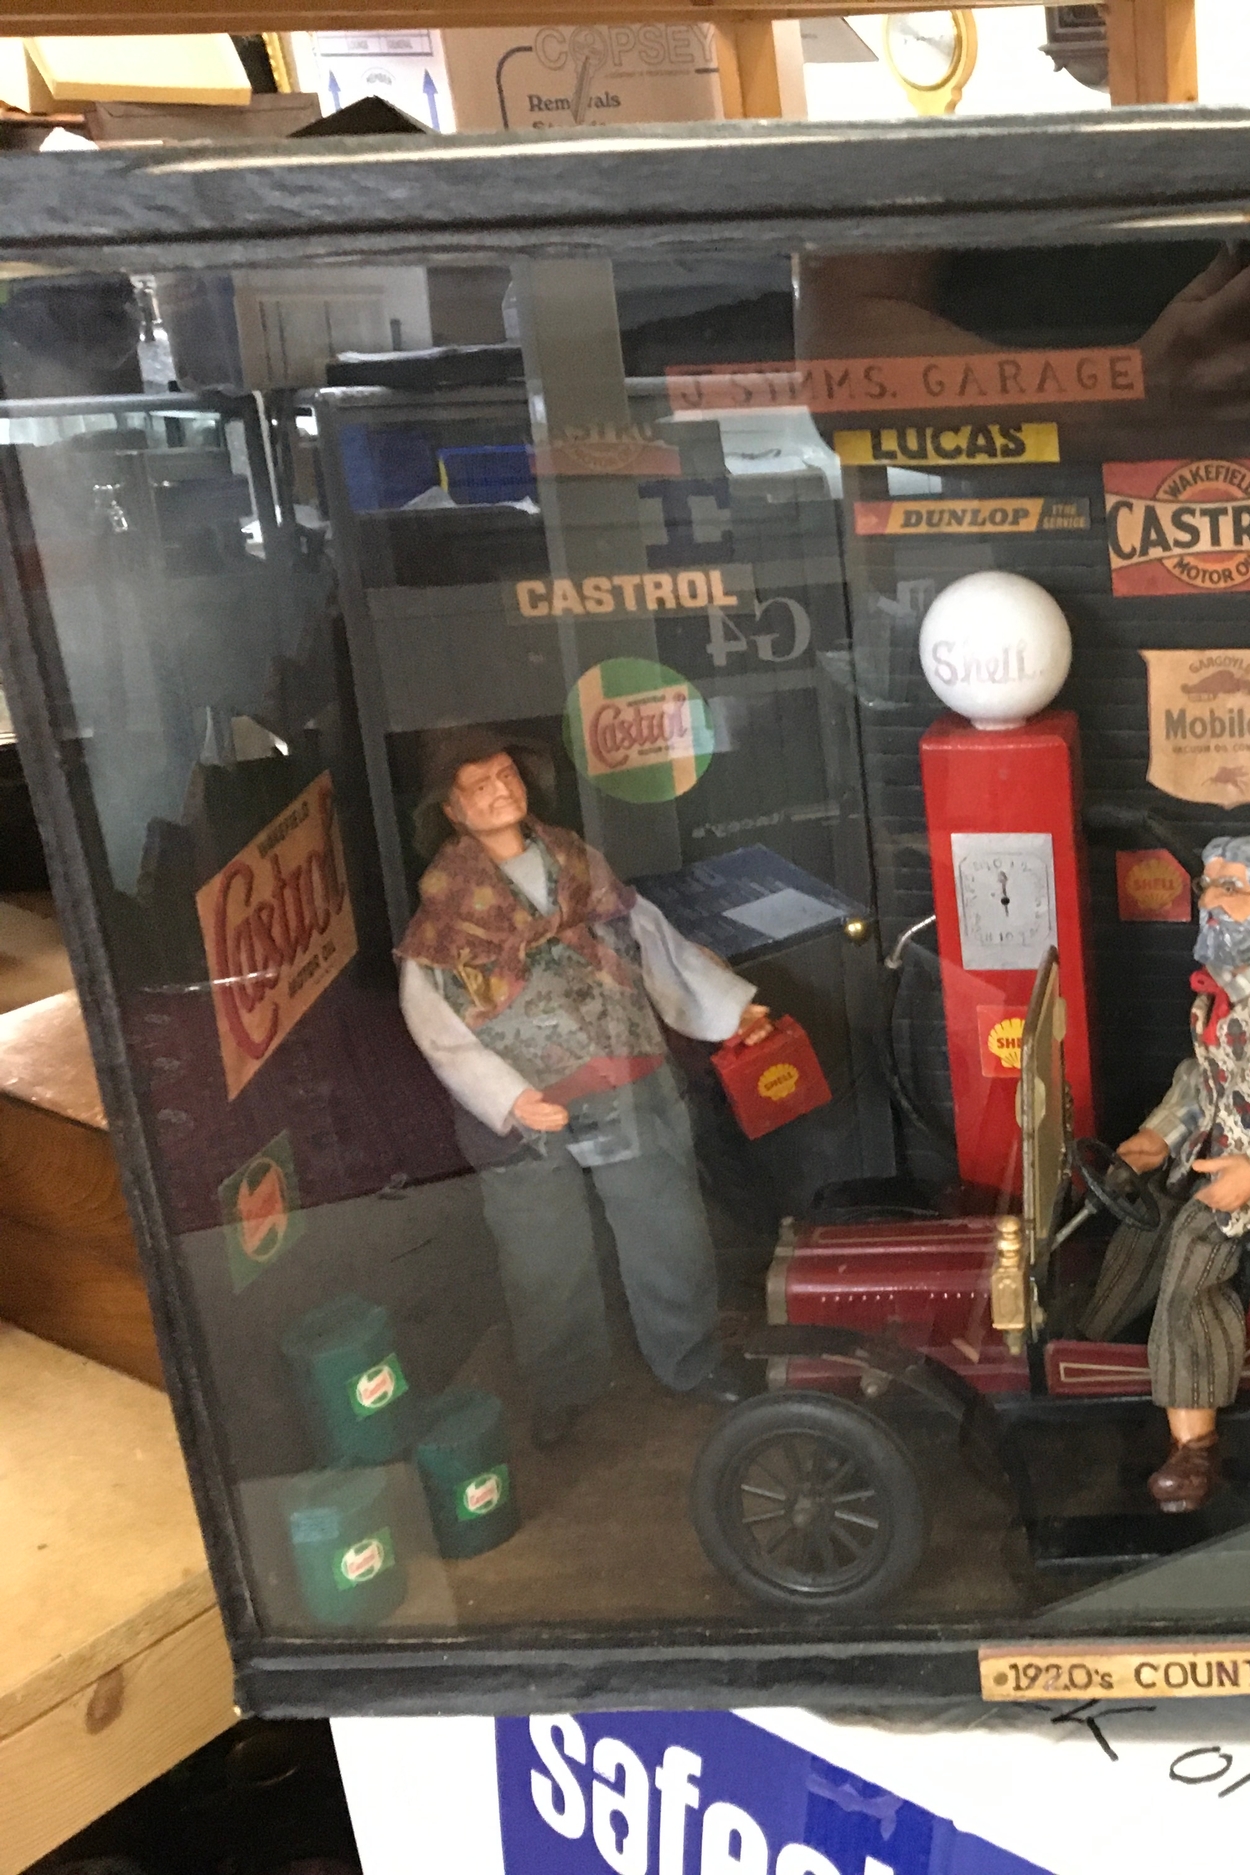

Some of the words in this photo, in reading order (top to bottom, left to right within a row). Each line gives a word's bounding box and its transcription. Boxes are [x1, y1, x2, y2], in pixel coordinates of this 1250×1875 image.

[534, 23, 715, 71] COPSEY
[922, 356, 1134, 397] GARAGE
[870, 424, 1027, 460] LUCAS
[901, 507, 1030, 528] DUNLOP
[1173, 554, 1233, 585] MOTOR
[516, 570, 738, 617] CASTROL
[932, 639, 1036, 686] Shell
[589, 692, 687, 768] Castrol
[215, 784, 346, 1060] Castrol
[1009, 1662, 1114, 1691] 1920's
